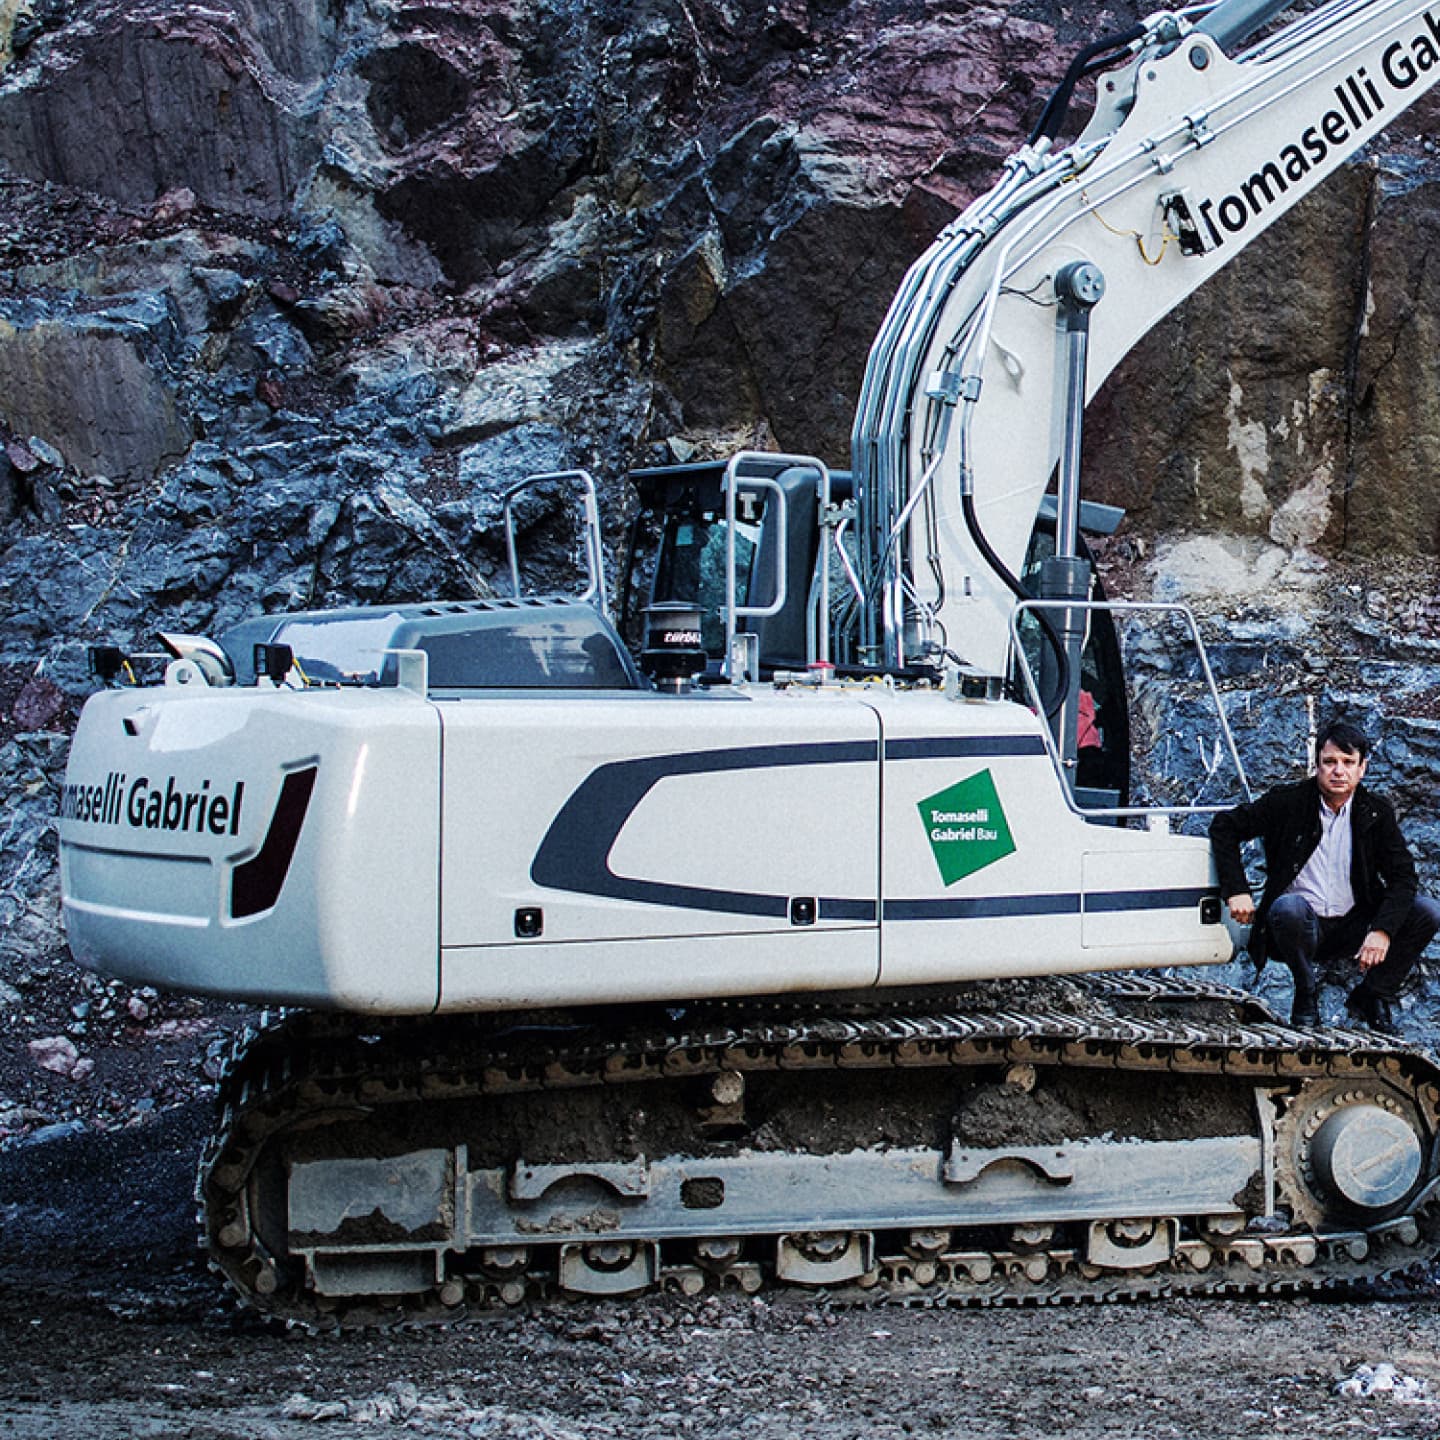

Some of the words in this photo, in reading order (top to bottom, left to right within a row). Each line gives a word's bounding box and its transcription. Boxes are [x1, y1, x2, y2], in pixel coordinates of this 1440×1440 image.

[1198, 66, 1385, 248] Tomaselli
[127, 776, 245, 836] Gabriel
[930, 808, 989, 823] Tomaselli
[930, 827, 976, 841] Gabriel
[976, 827, 998, 841] Bau
